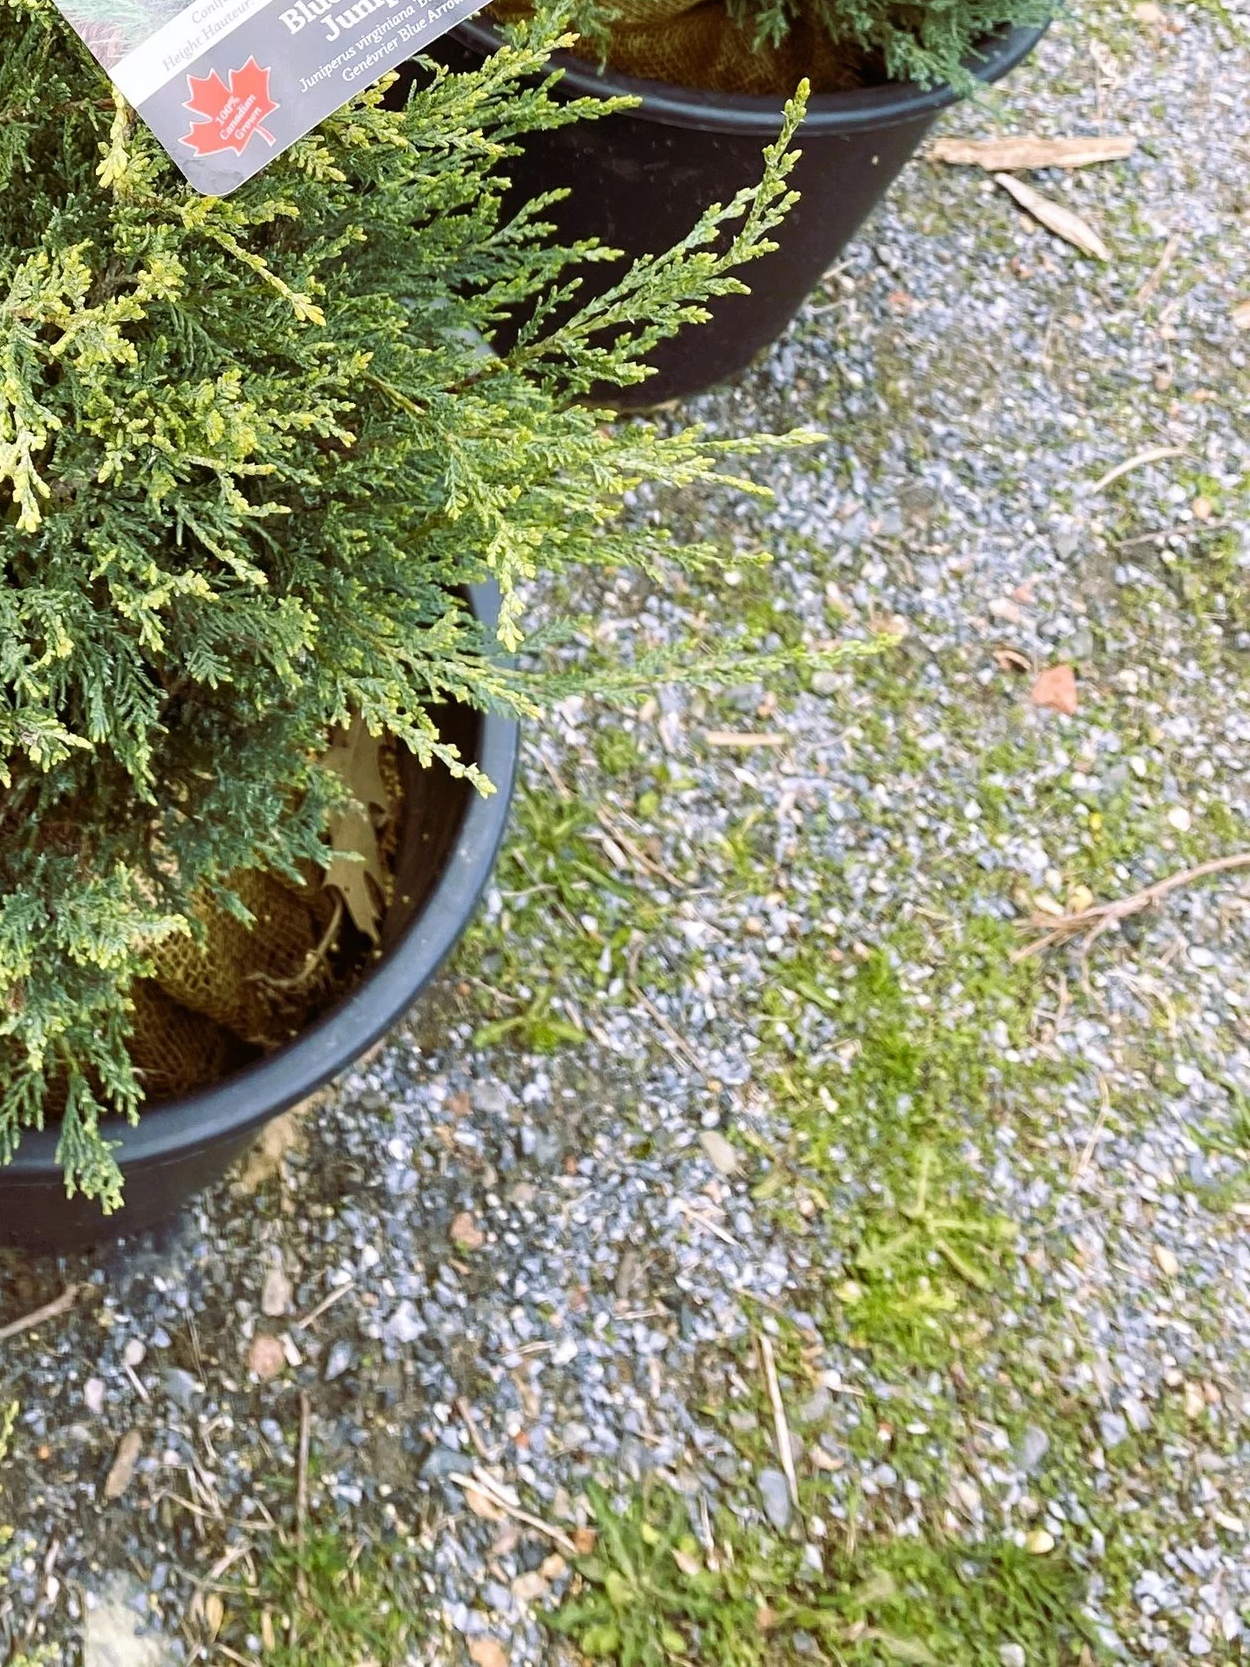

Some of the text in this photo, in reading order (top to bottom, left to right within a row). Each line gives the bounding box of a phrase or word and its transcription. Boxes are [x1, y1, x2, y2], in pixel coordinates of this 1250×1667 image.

[163, 37, 202, 71] Height
[299, 47, 356, 93] Juniperus
[356, 6, 415, 49] virginiana
[342, 38, 398, 81] Genévrier
[397, 19, 427, 42] Blue
[214, 94, 241, 127] 100%
[219, 93, 257, 141] Canadian
[234, 106, 262, 140] Grown
